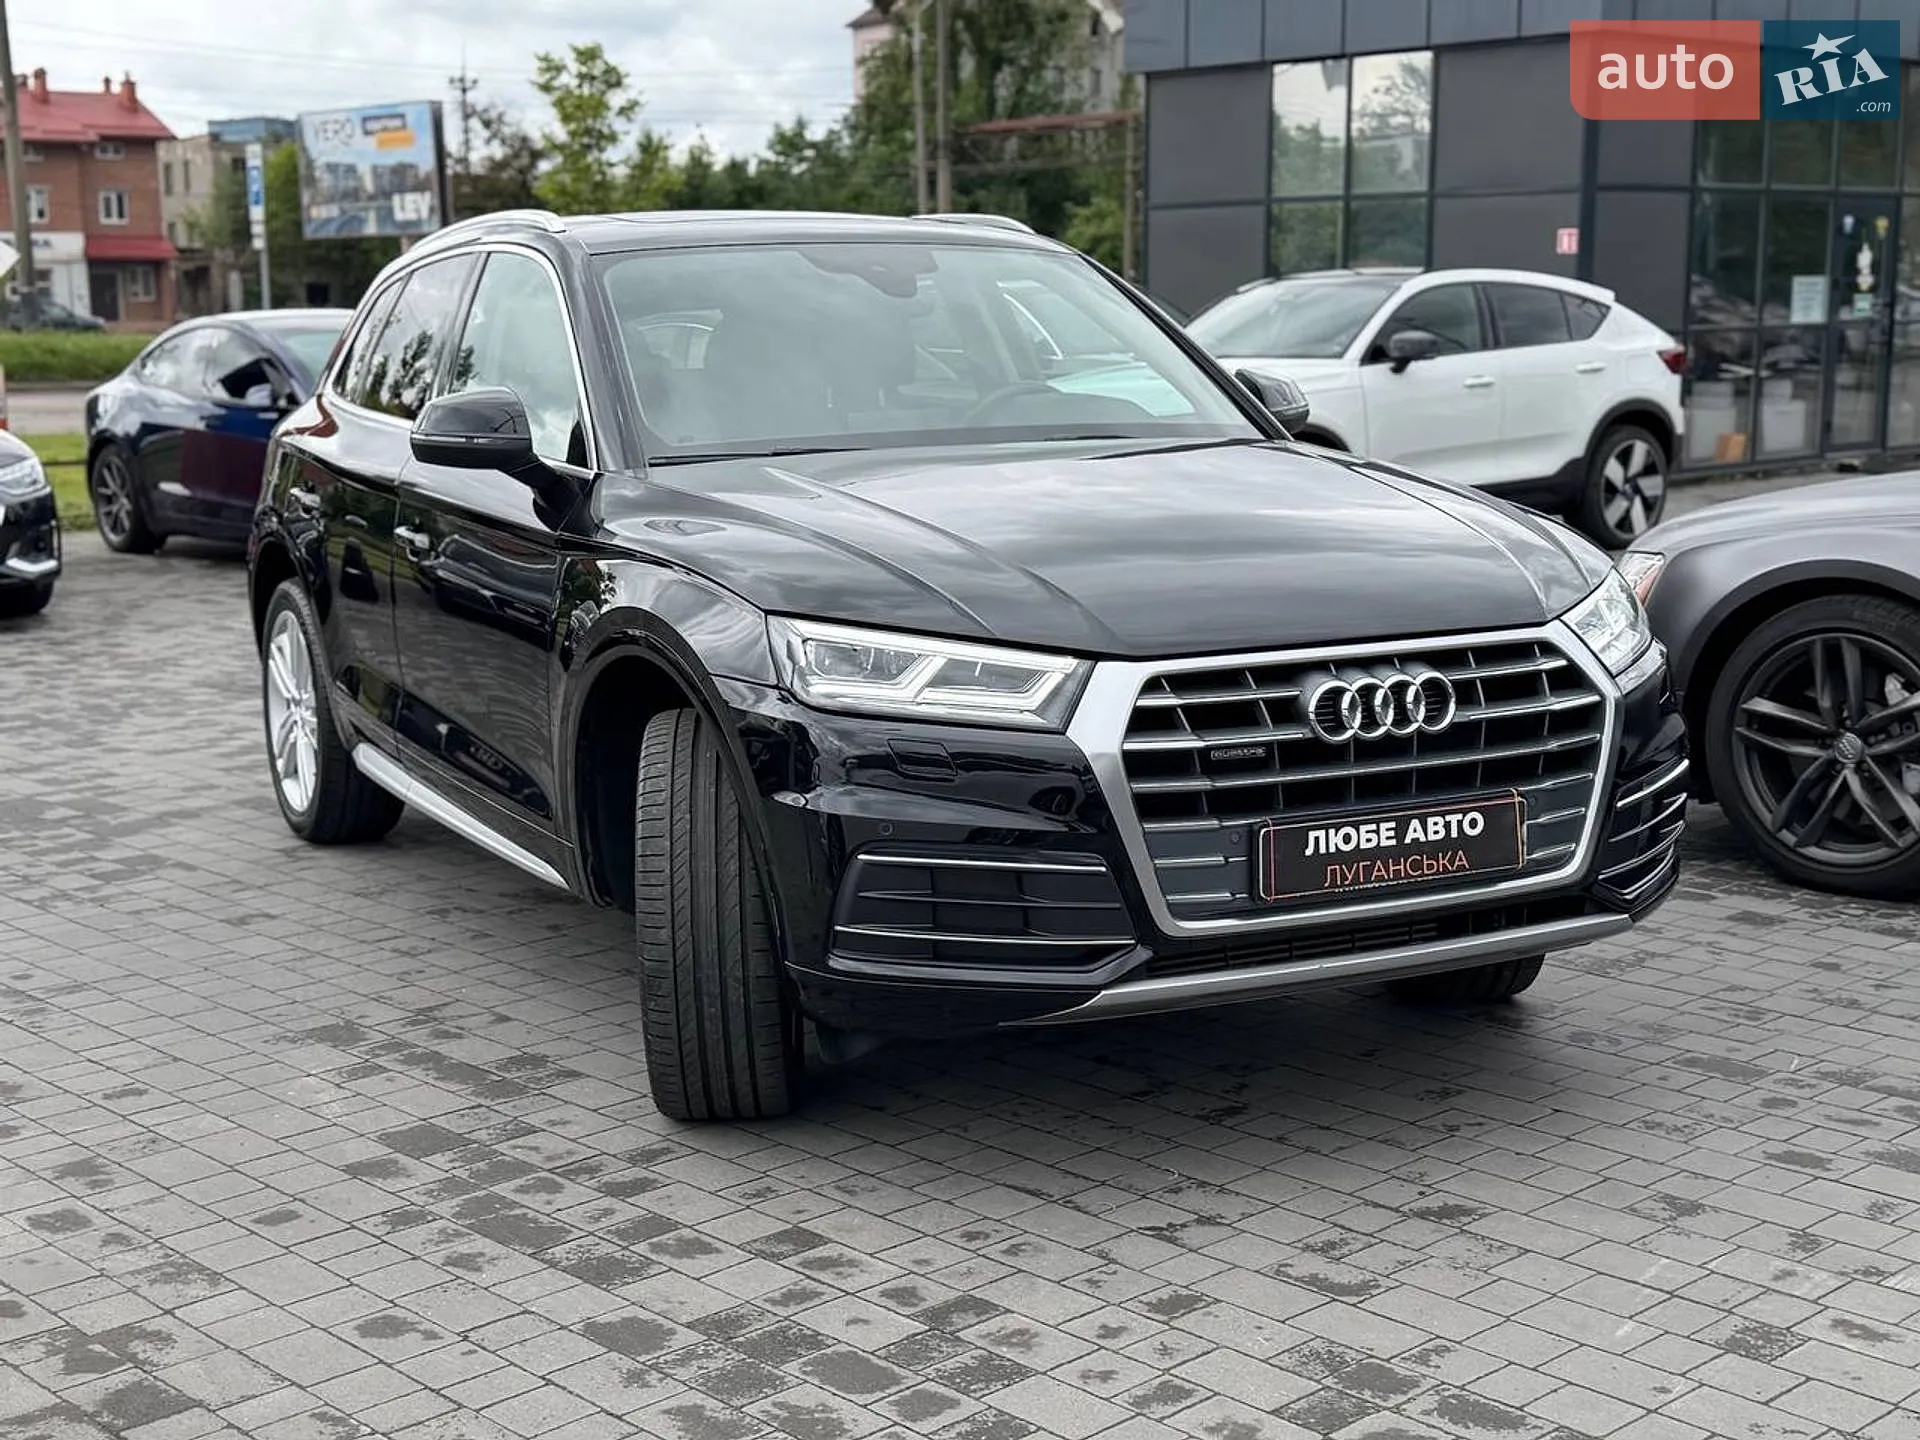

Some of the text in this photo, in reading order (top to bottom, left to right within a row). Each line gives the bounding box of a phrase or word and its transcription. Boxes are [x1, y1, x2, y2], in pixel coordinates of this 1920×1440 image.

[1304, 811, 1485, 857] ЛЮБЕ АВТО
[1324, 849, 1469, 887] ЛУГАНСЬКА
